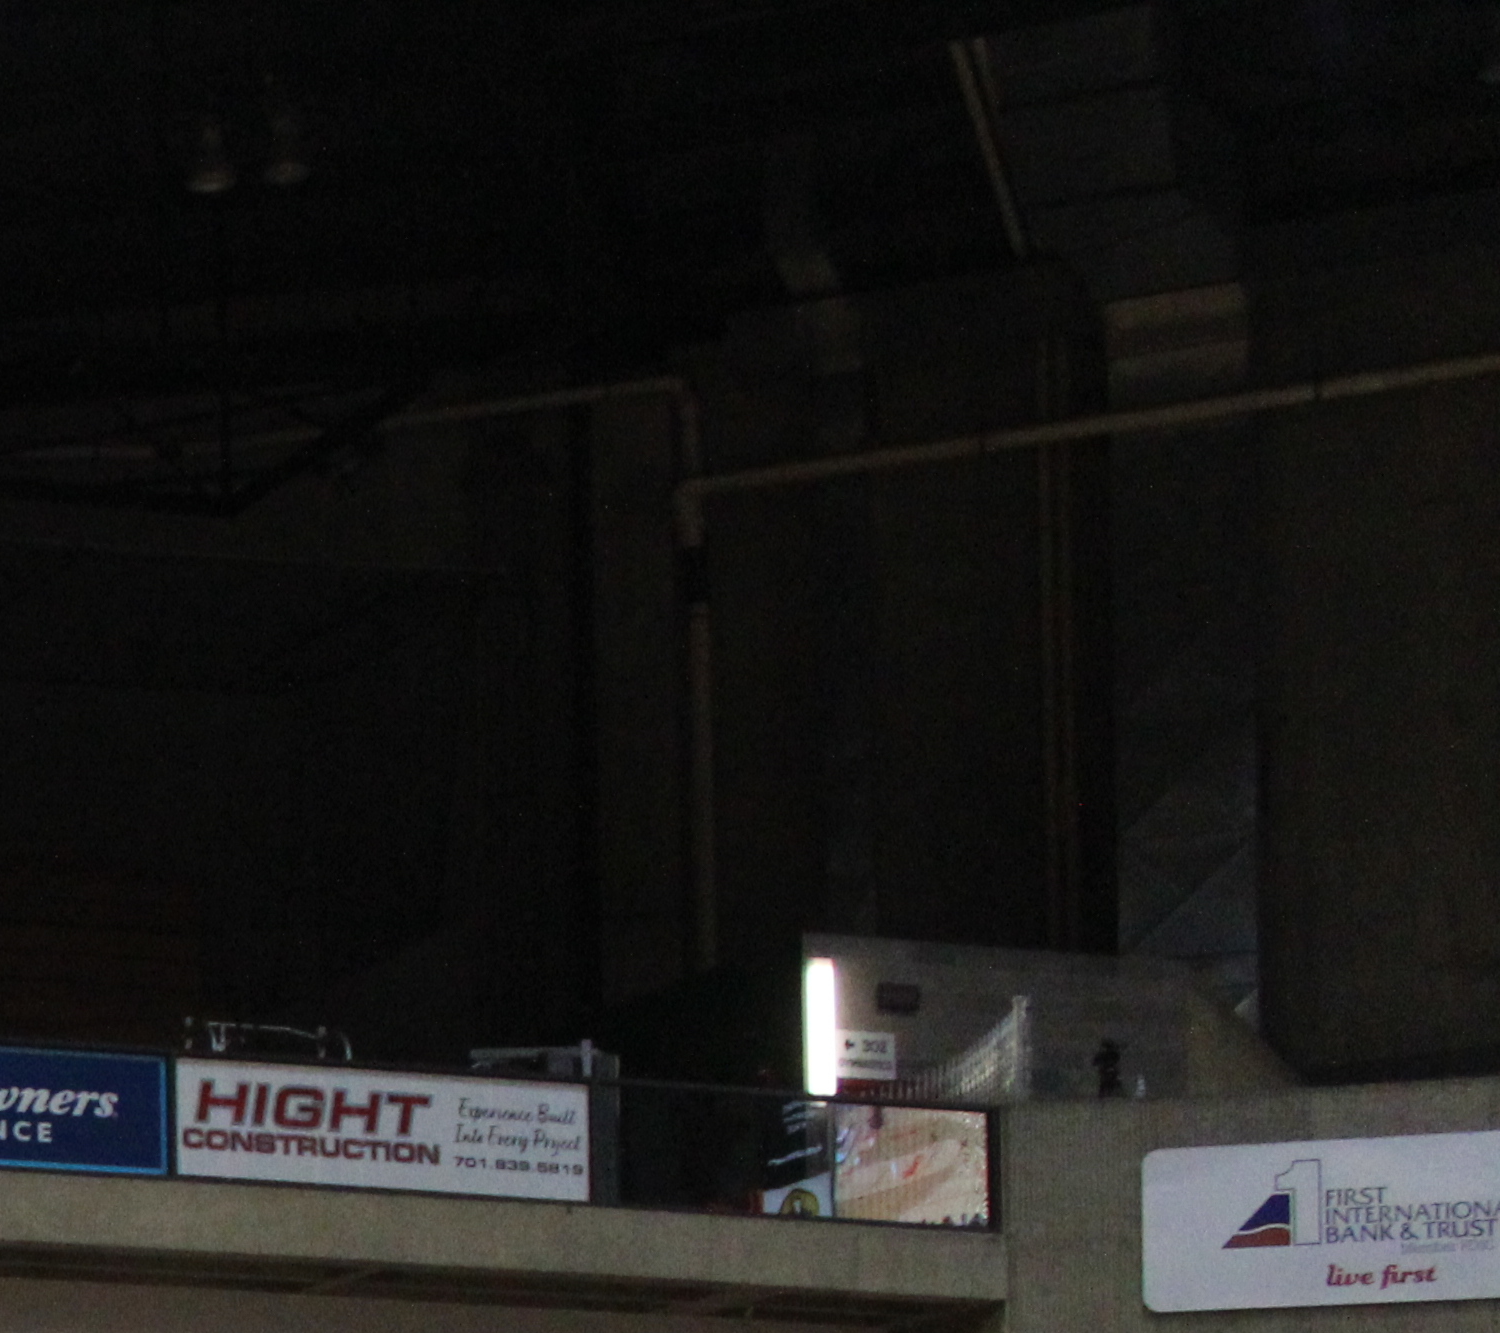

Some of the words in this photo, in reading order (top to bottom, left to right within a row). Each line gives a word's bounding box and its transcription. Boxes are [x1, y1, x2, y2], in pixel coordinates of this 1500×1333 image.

[195, 1079, 432, 1137] HIGHT
[458, 1097, 534, 1123] Experience
[182, 1128, 440, 1165] CONSTRUCTION
[487, 1125, 529, 1153] Every
[533, 1128, 582, 1156] Project
[1325, 1186, 1387, 1207] FIRST
[1325, 1224, 1395, 1244] BANK
[1401, 1223, 1418, 1241] &
[1423, 1218, 1498, 1238] TRUST
[1326, 1263, 1376, 1287] live
[1379, 1264, 1439, 1290] first
